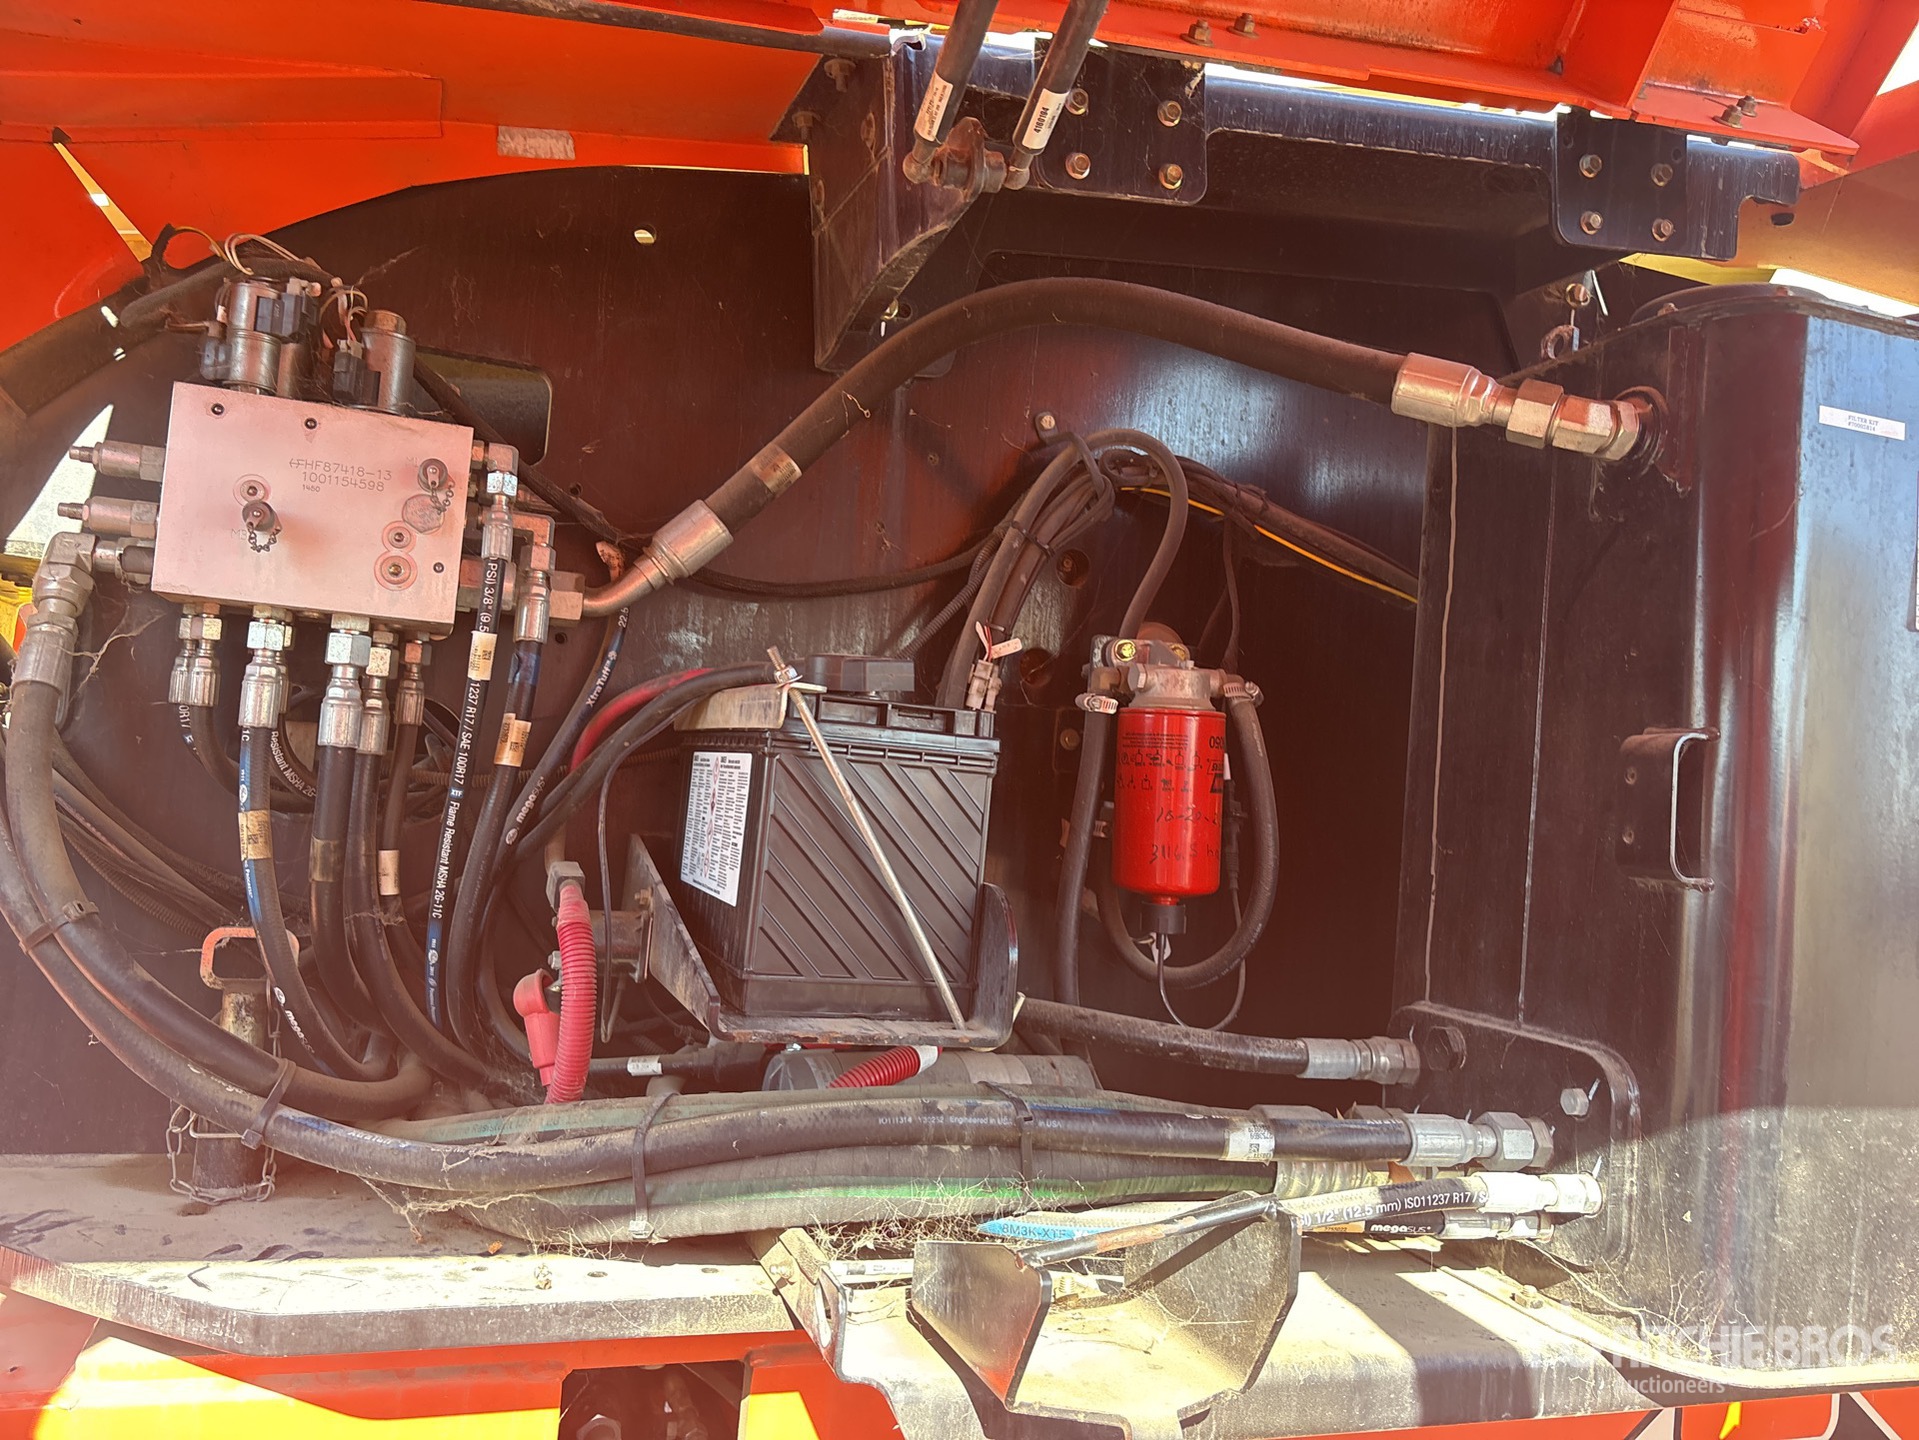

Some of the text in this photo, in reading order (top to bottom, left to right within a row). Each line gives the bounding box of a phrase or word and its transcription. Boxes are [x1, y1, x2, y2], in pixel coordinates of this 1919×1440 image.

[302, 471, 385, 492] 1001154598
[482, 587, 495, 610] 3/8"
[464, 705, 477, 728] R17
[460, 731, 472, 750] SAE
[271, 731, 290, 771] Resistant
[283, 766, 304, 791] MSHA
[454, 751, 469, 785] 100R17
[431, 800, 460, 919] Flame Resistant MSHA 2G-11C
[949, 1115, 988, 1126] Engineered
[989, 1117, 998, 1125] in
[1046, 1120, 1063, 1128] USA
[1342, 1205, 1374, 1221] (12.5
[1375, 1198, 1402, 1214] mm)
[1404, 1192, 1450, 1210] ISO11237
[1452, 1191, 1471, 1204] R17
